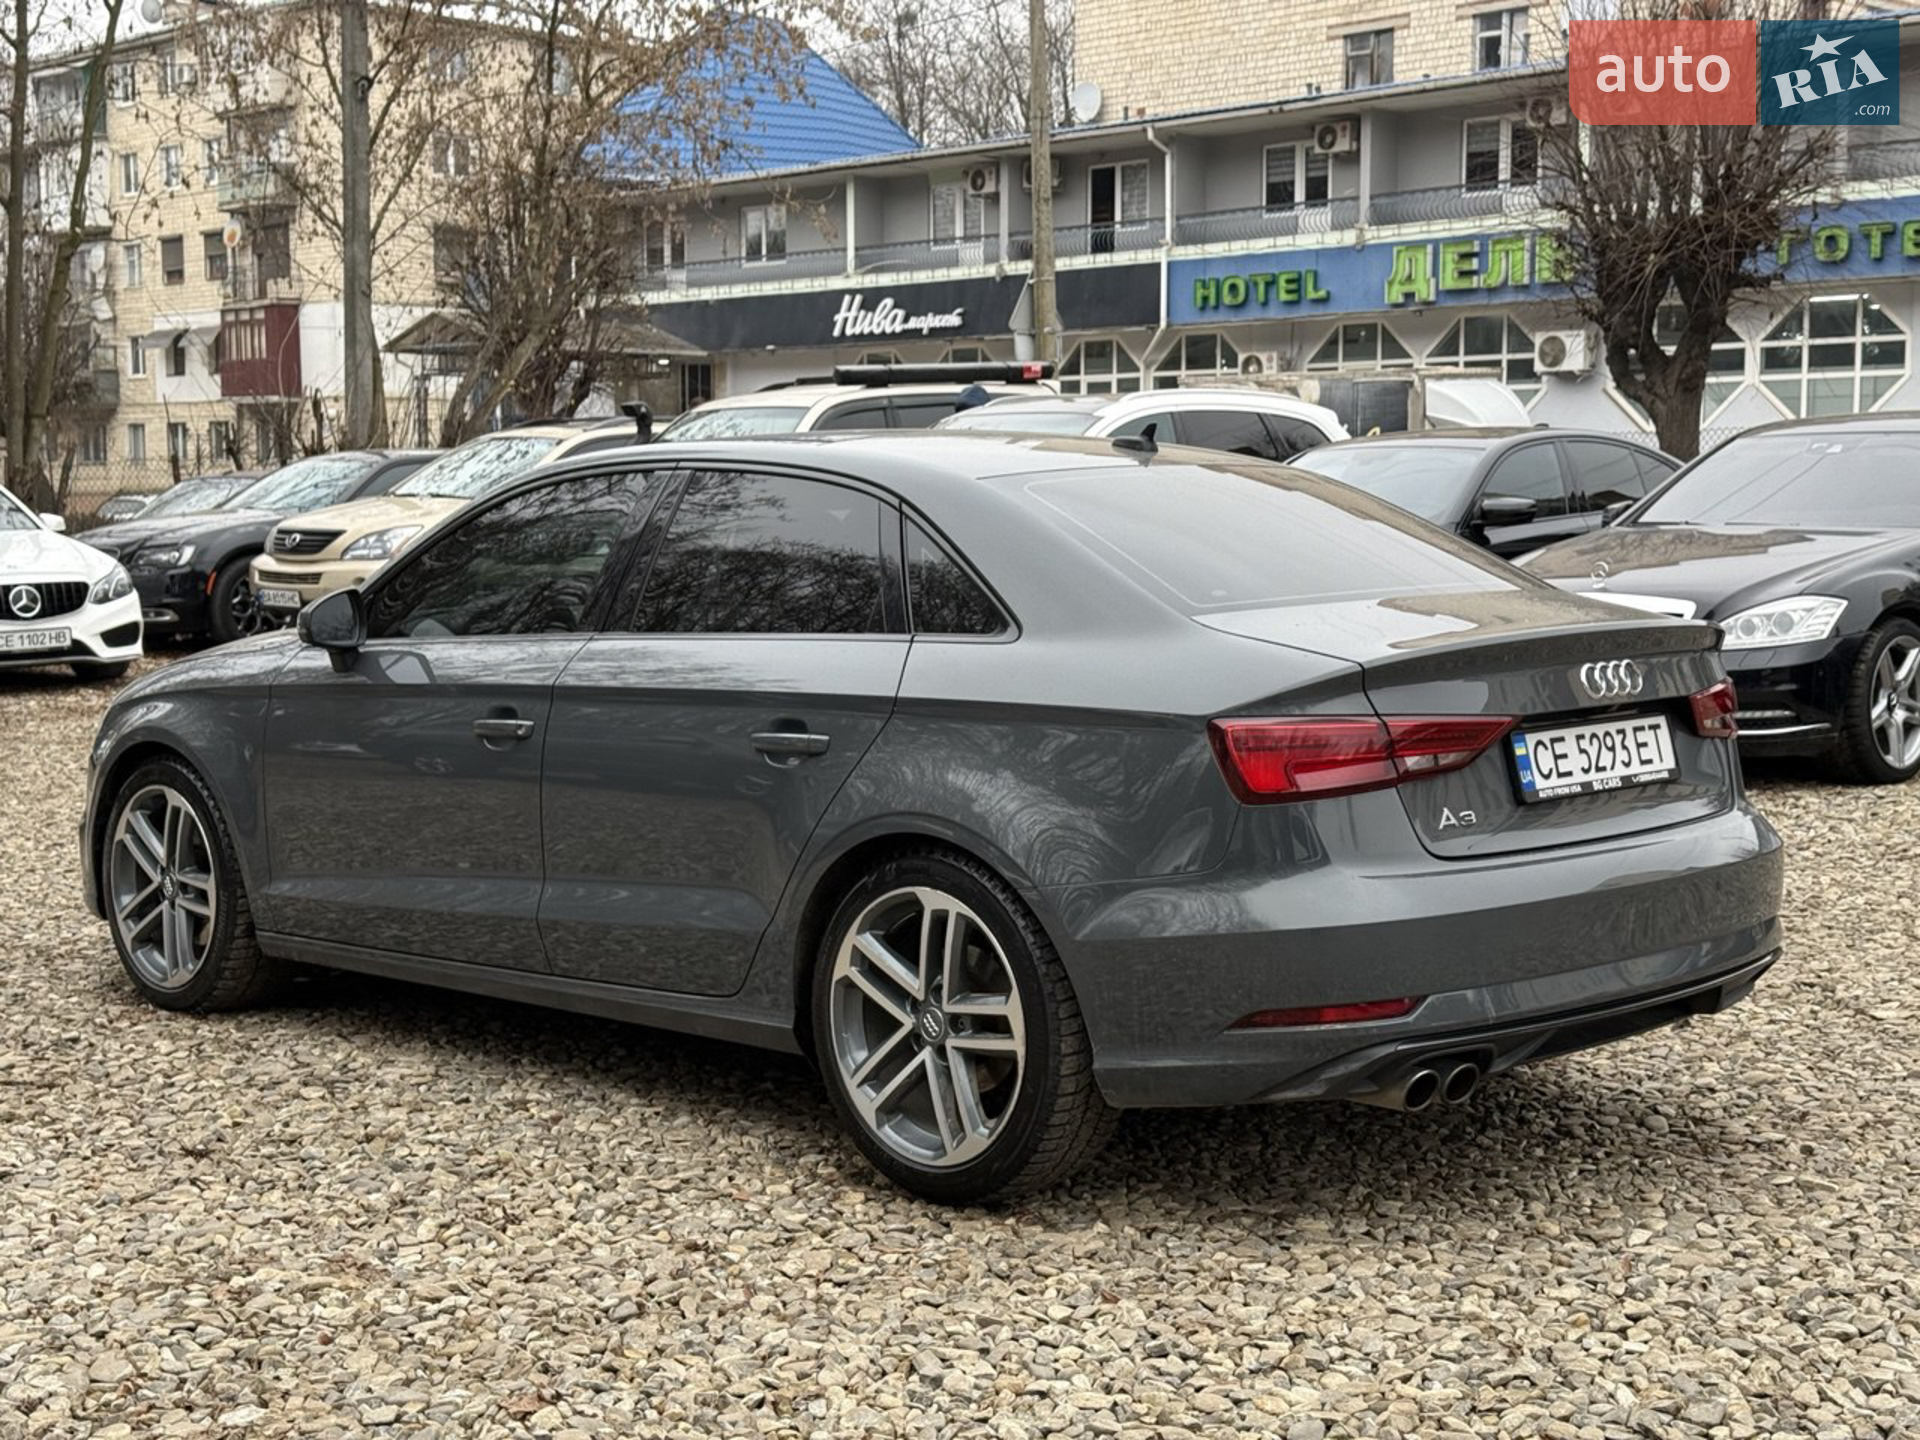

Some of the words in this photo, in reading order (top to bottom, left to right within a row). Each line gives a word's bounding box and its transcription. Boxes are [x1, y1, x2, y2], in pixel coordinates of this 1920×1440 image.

[1194, 270, 1331, 311] HOTEL
[832, 293, 906, 337] Нива
[18, 632, 47, 647] 1102
[48, 630, 67, 644] HB
[1533, 736, 1573, 780] CE
[1575, 728, 1632, 774] 5293
[1631, 723, 1664, 766] ET
[1604, 776, 1623, 789] CARS
[1438, 806, 1477, 830] A3
